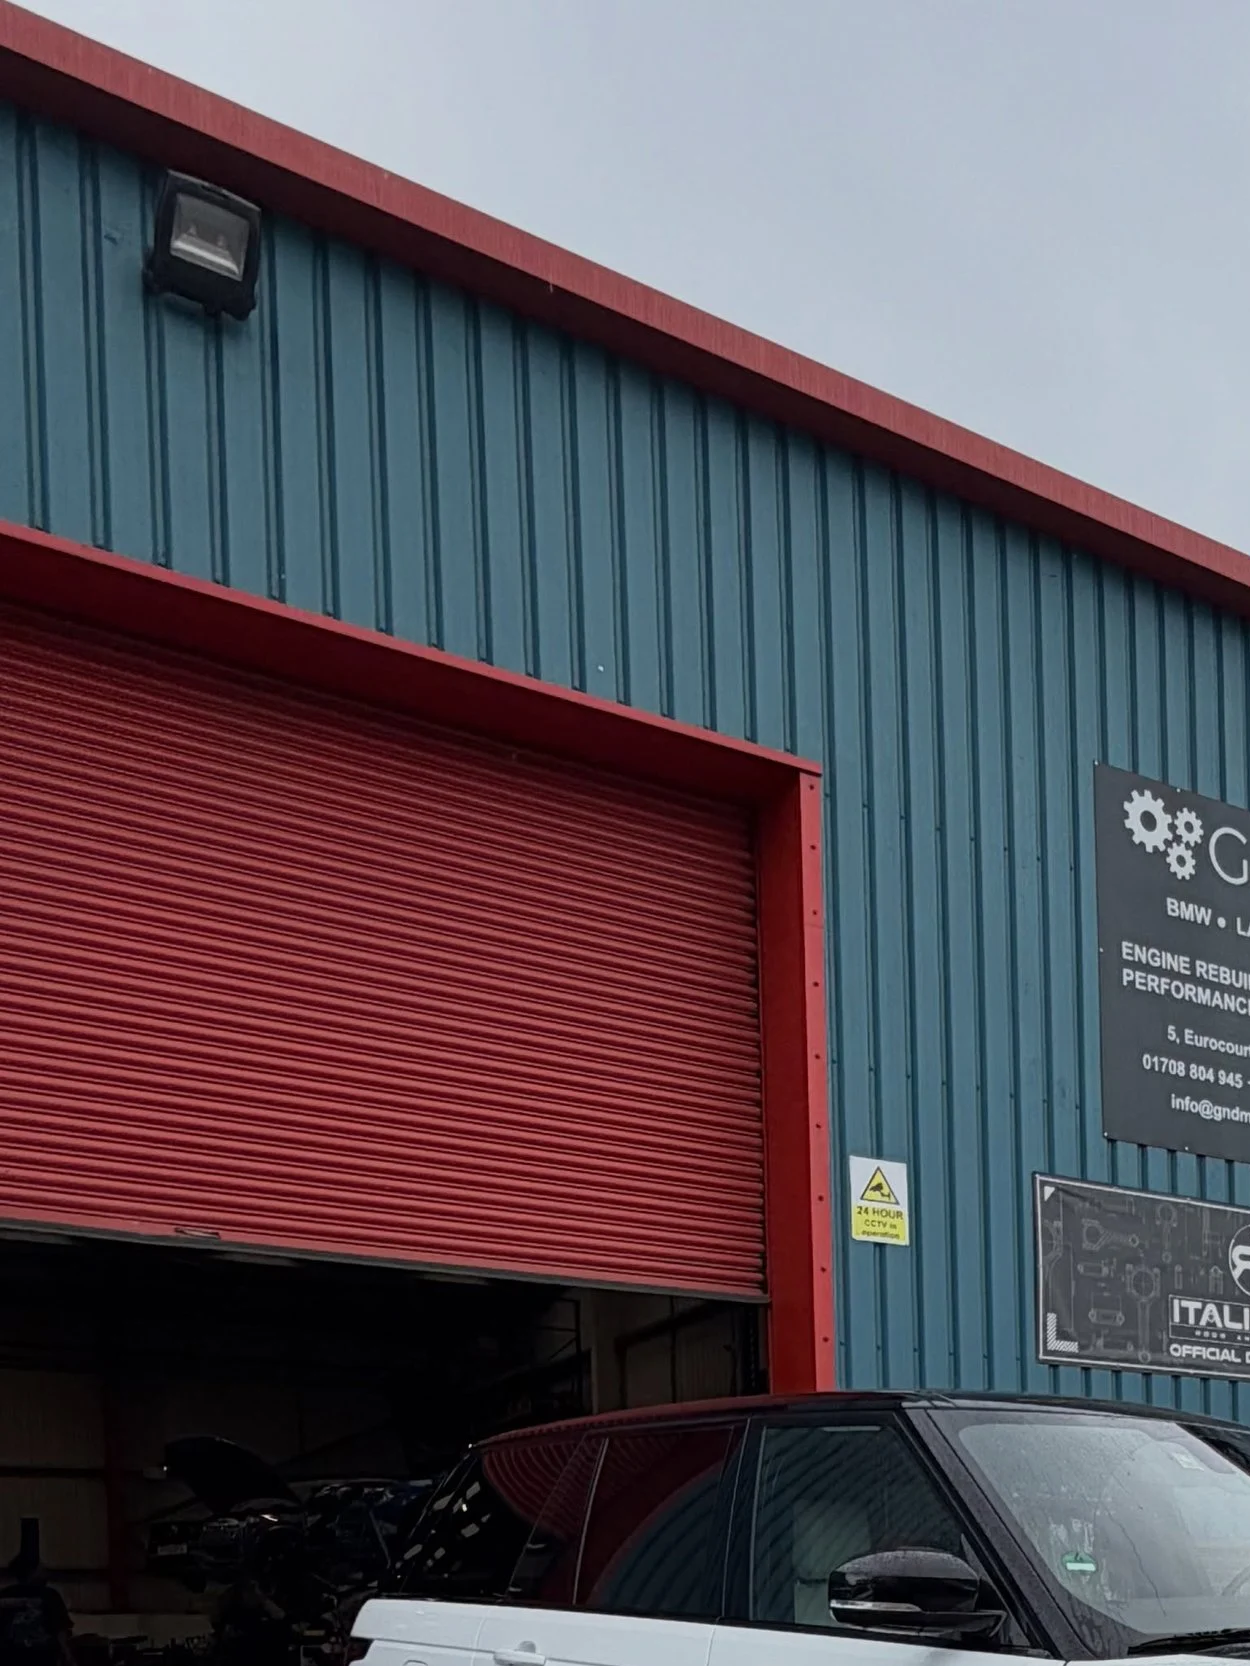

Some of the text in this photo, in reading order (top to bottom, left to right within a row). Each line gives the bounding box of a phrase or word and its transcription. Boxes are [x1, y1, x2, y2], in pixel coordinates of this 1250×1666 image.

[1166, 897, 1212, 926] BMW
[1121, 941, 1192, 975] ENGINE
[1167, 1025, 1180, 1044] 5,
[1142, 1053, 1186, 1077] 01708
[1189, 1063, 1214, 1084] 804
[1218, 1071, 1243, 1089] 945
[856, 1206, 903, 1220] 24 HOUR
[863, 1219, 888, 1228] CCTV
[1169, 1344, 1242, 1363] OFFICIAL
